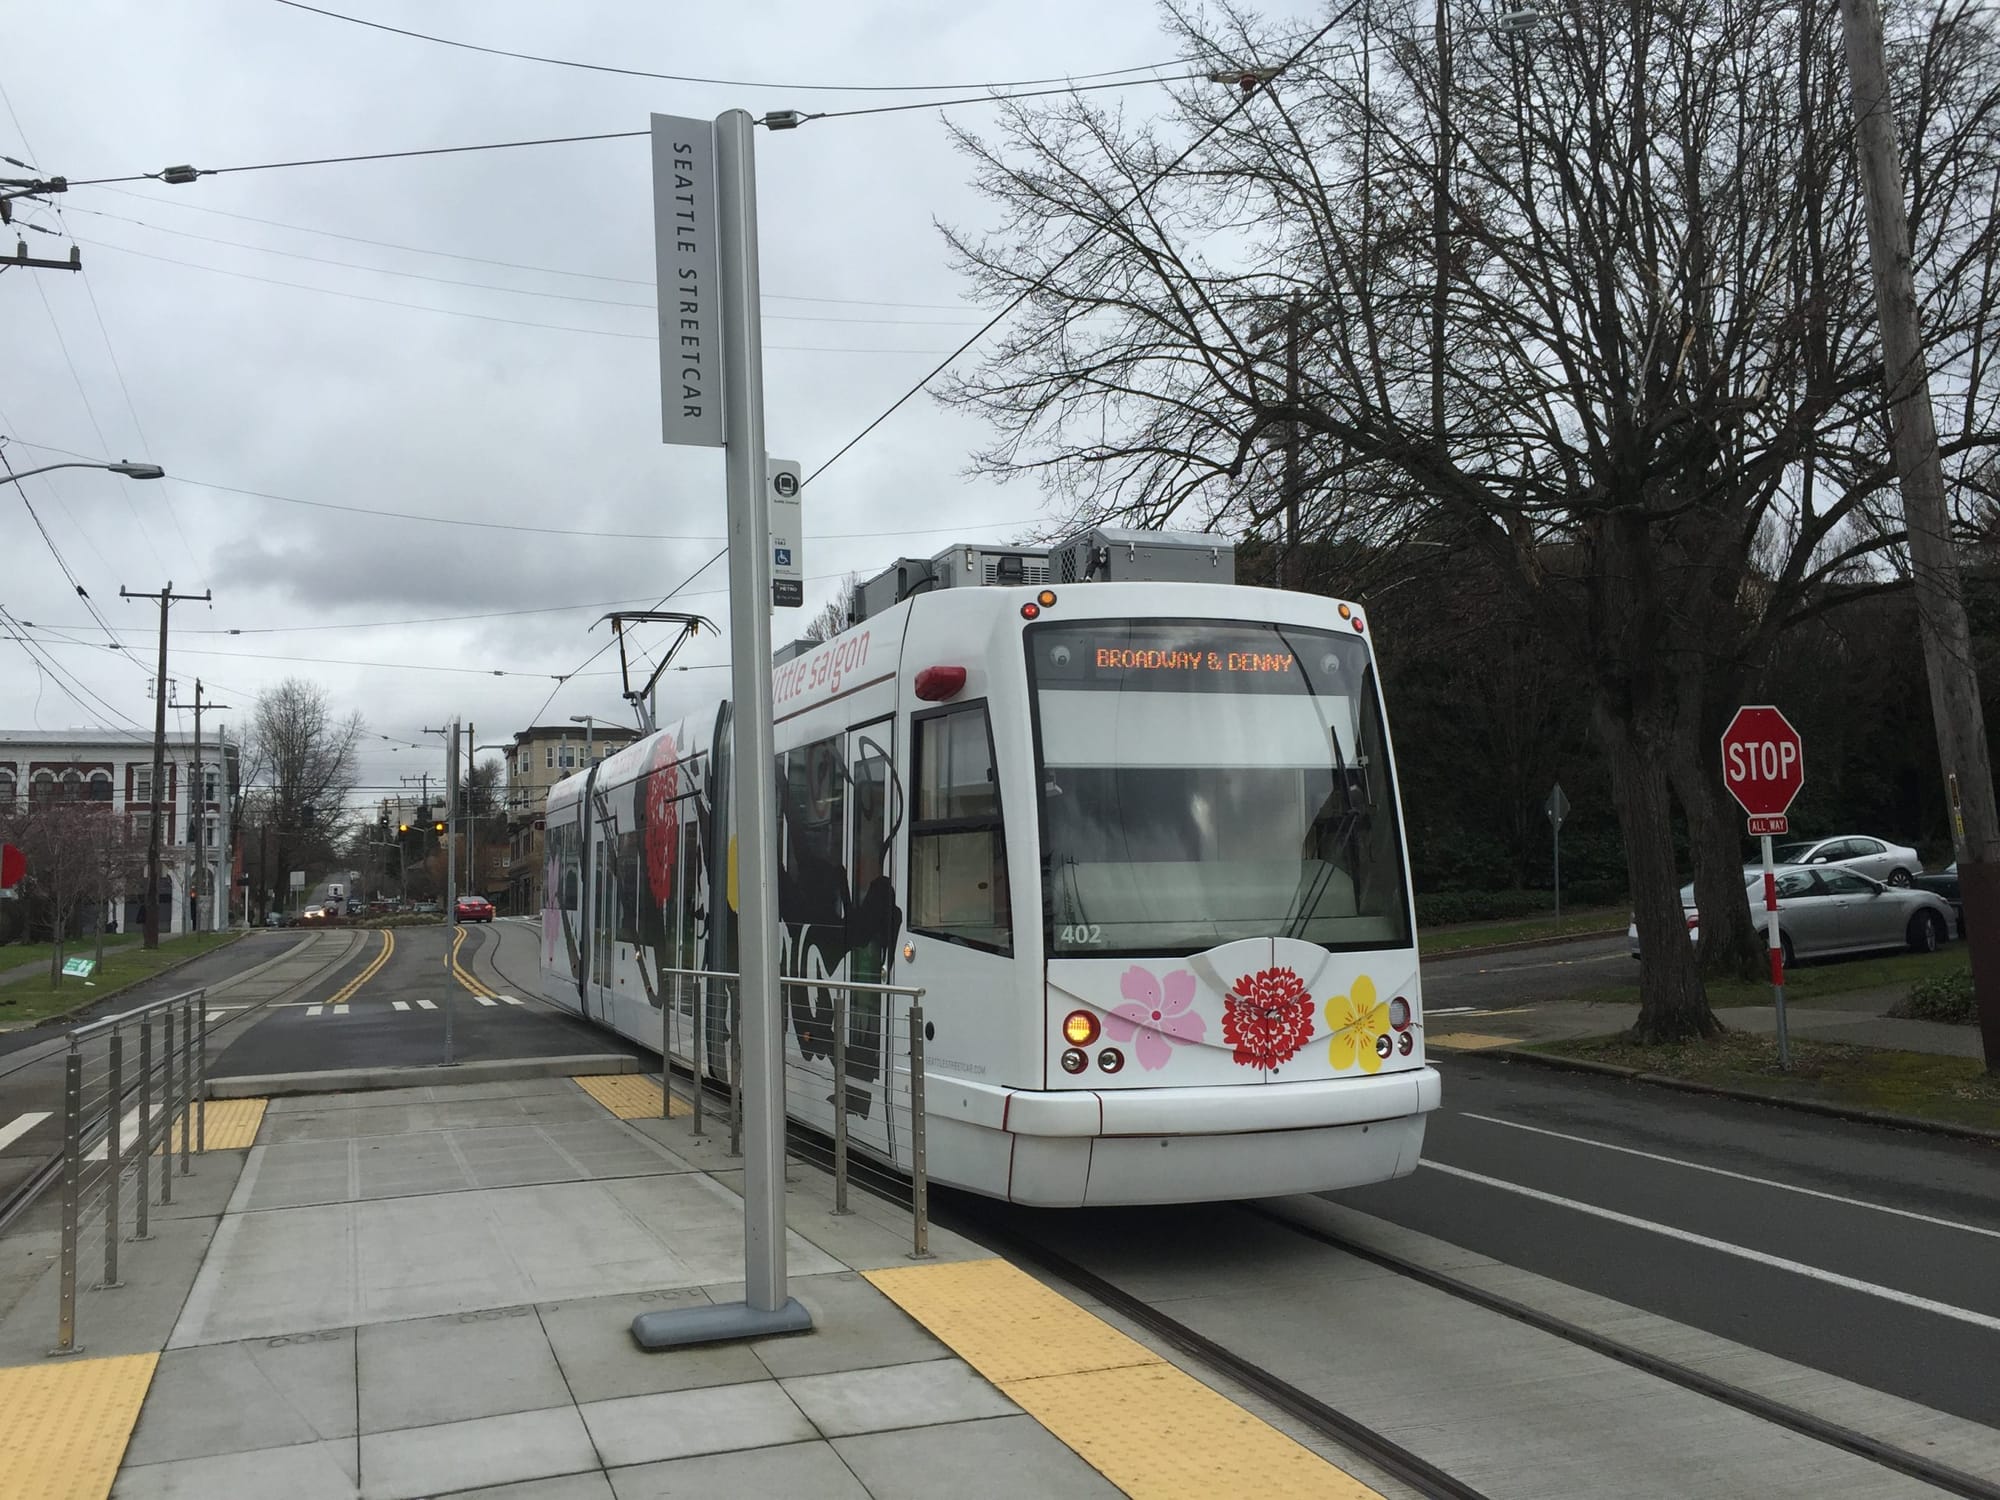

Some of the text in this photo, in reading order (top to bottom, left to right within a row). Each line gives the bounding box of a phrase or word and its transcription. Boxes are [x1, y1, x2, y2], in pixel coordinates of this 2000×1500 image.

[673, 142, 702, 418] SEATTLE STREETCAR
[808, 631, 870, 693] saigon
[1097, 649, 1293, 672] BROADWAY & DENNY
[1729, 741, 1796, 781] STOP
[1752, 820, 1784, 831] ALL WAY
[1060, 924, 1102, 944] 402
